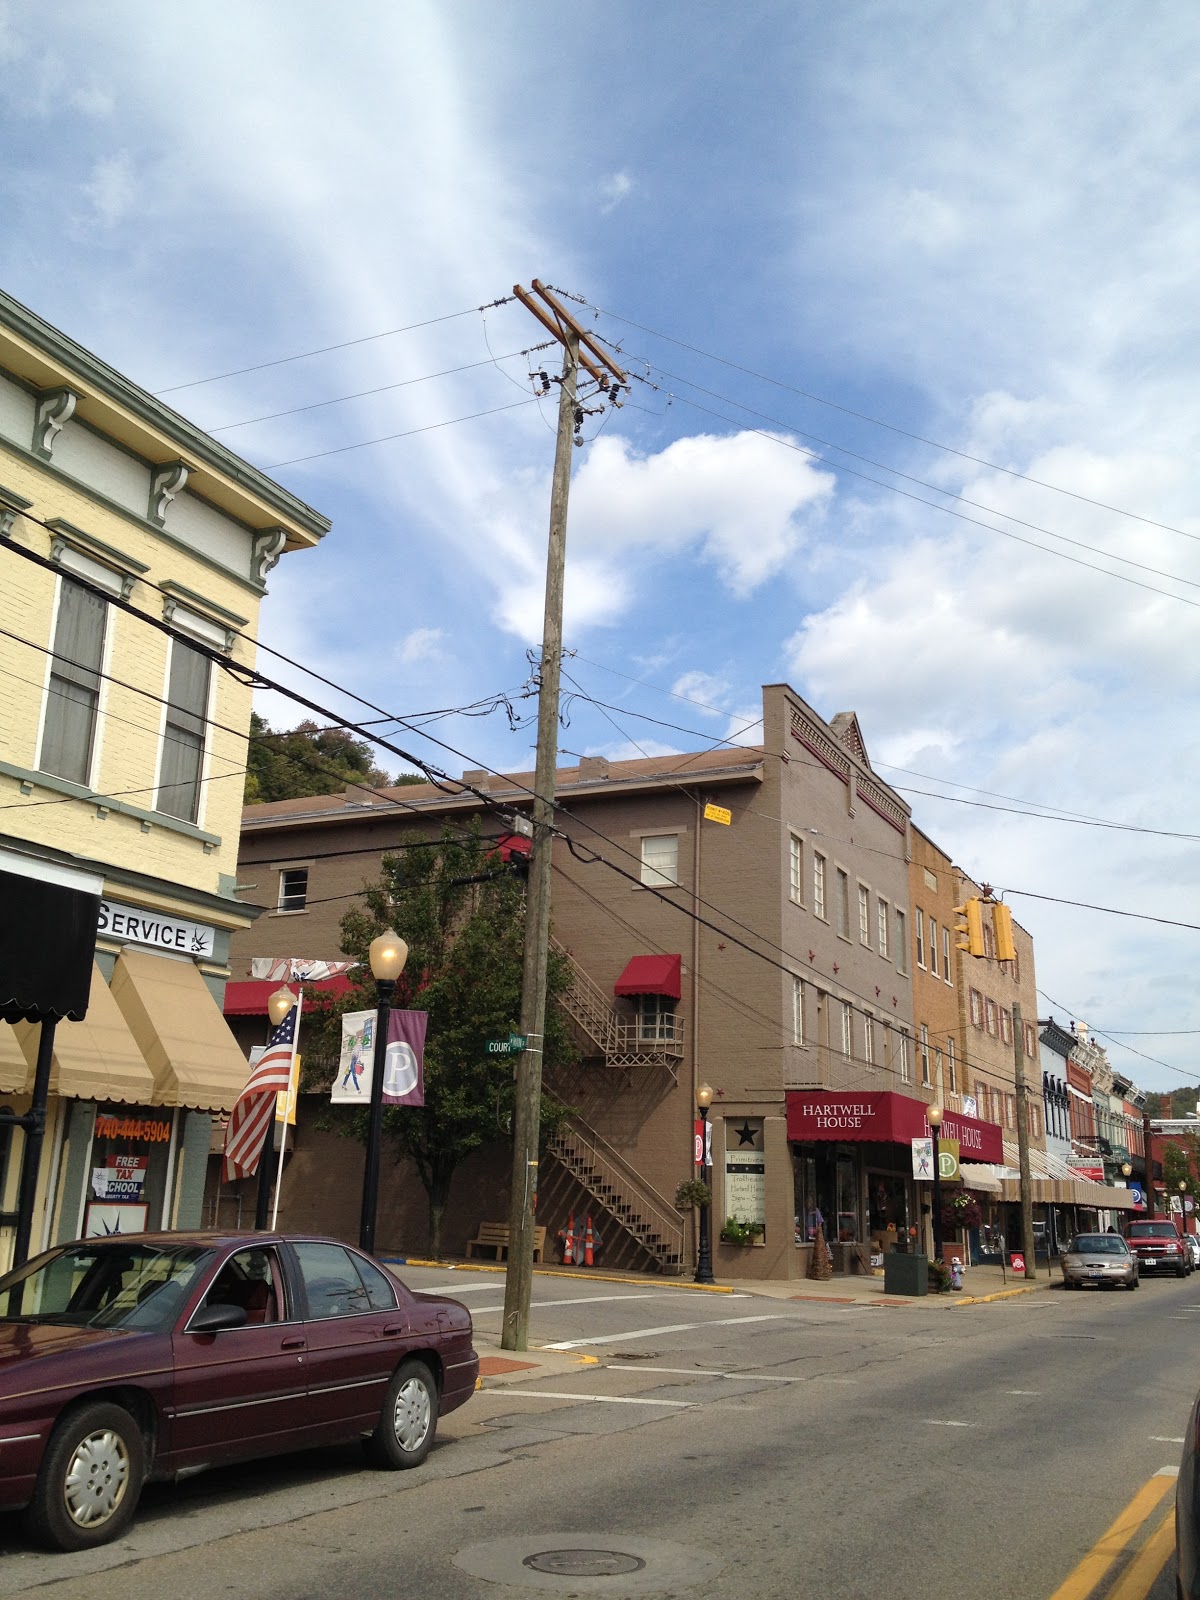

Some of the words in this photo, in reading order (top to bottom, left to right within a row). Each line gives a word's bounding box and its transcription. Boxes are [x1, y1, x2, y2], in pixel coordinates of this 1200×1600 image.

[97, 902, 187, 948] SERVICE
[386, 1052, 410, 1085] P
[803, 1104, 876, 1116] HARTWELL
[816, 1116, 862, 1128] HOUSE
[96, 1118, 171, 1142] 740-444-5904
[923, 1114, 961, 1145] HTWELL
[961, 1126, 982, 1149] HOUSE
[115, 1156, 140, 1167] FREE
[941, 1157, 951, 1172] P
[116, 1168, 134, 1180] TAX
[107, 1182, 139, 1193] CHOOL
